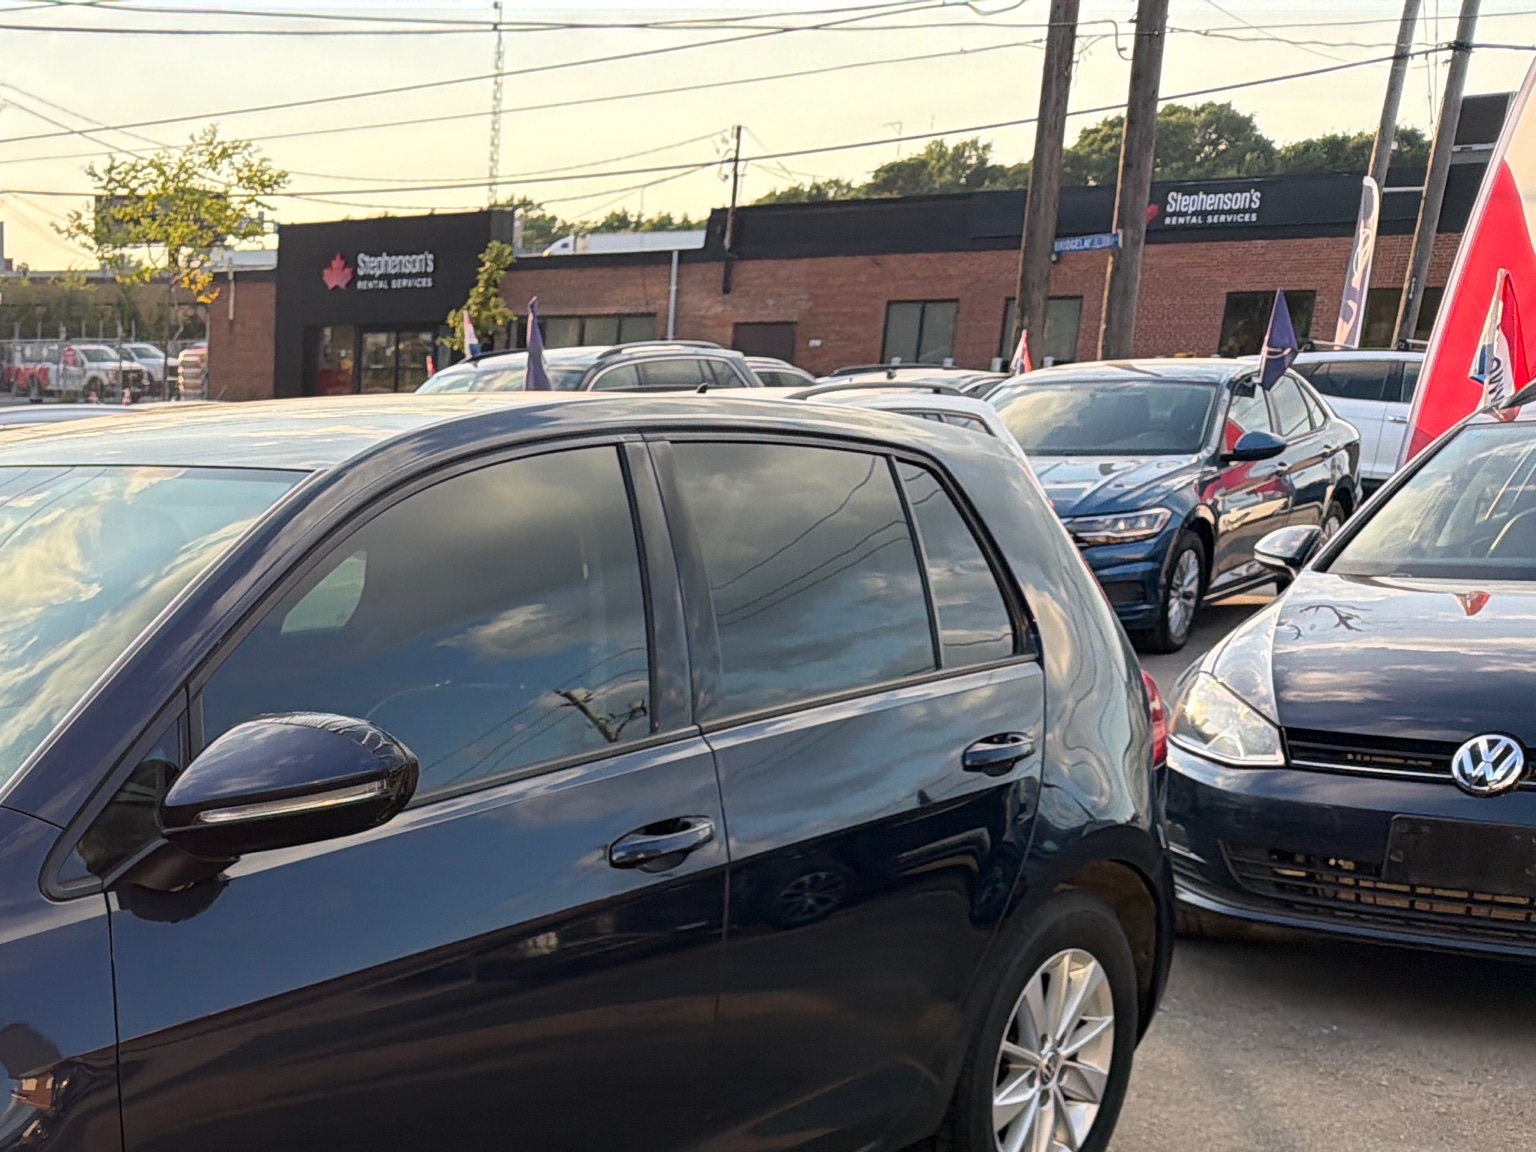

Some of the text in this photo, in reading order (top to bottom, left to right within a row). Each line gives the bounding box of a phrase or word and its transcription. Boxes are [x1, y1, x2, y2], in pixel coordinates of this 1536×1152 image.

[1166, 188, 1262, 214] Stephenson's
[1164, 212, 1258, 225] RENTAL SERVICES
[357, 251, 434, 277] Stephenson's
[356, 277, 433, 290] RENTAL SERVICES
